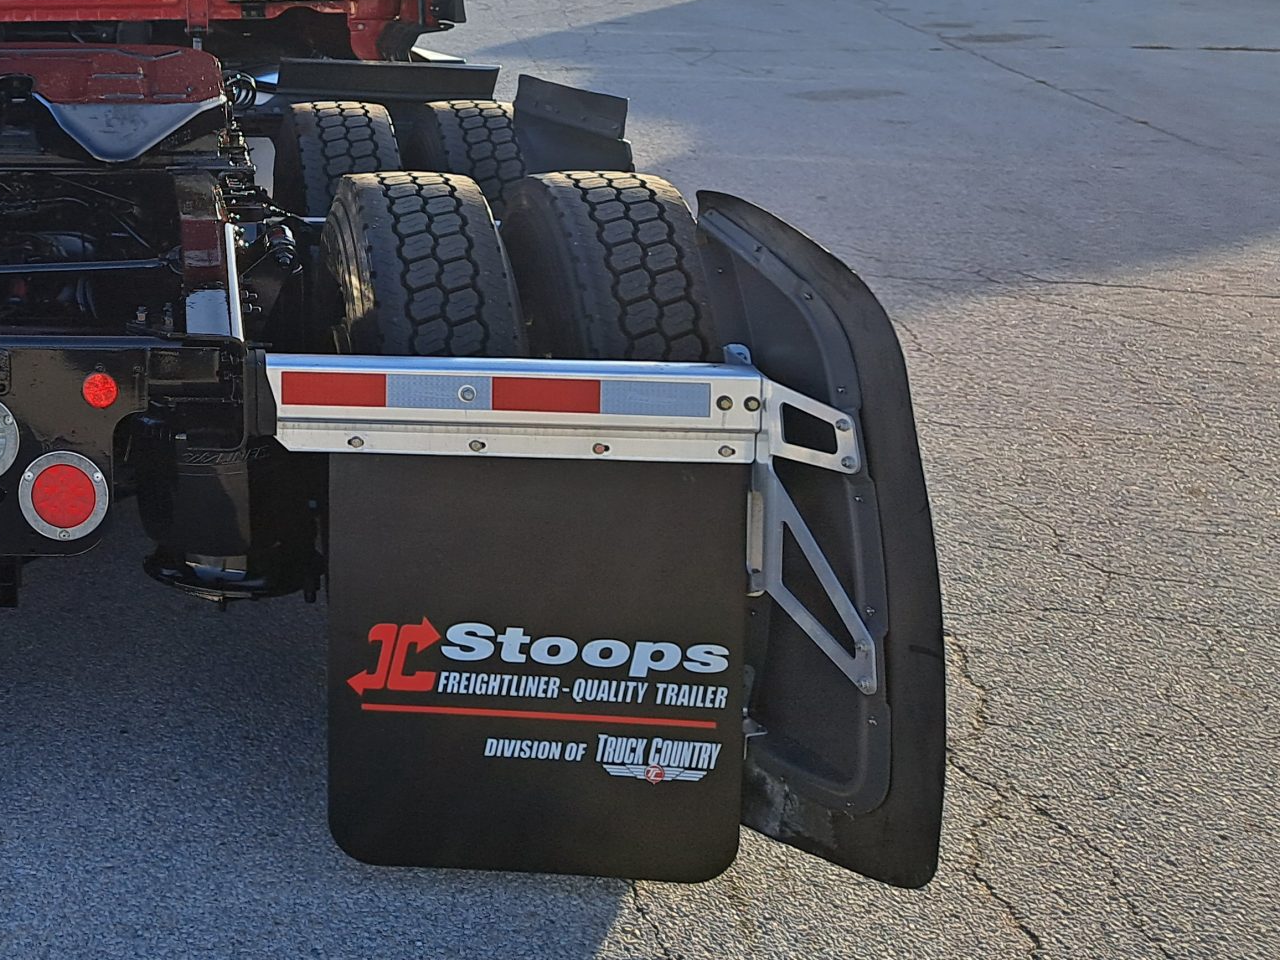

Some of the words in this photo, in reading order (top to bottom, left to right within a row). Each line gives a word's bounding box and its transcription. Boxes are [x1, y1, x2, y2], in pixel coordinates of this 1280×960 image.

[440, 622, 730, 678] Stoops
[655, 683, 729, 709] TRAILER
[484, 739, 561, 761] DIVISION
[564, 742, 586, 762] OF
[595, 734, 648, 766] TRUCK
[649, 738, 722, 770] COUNTRY
